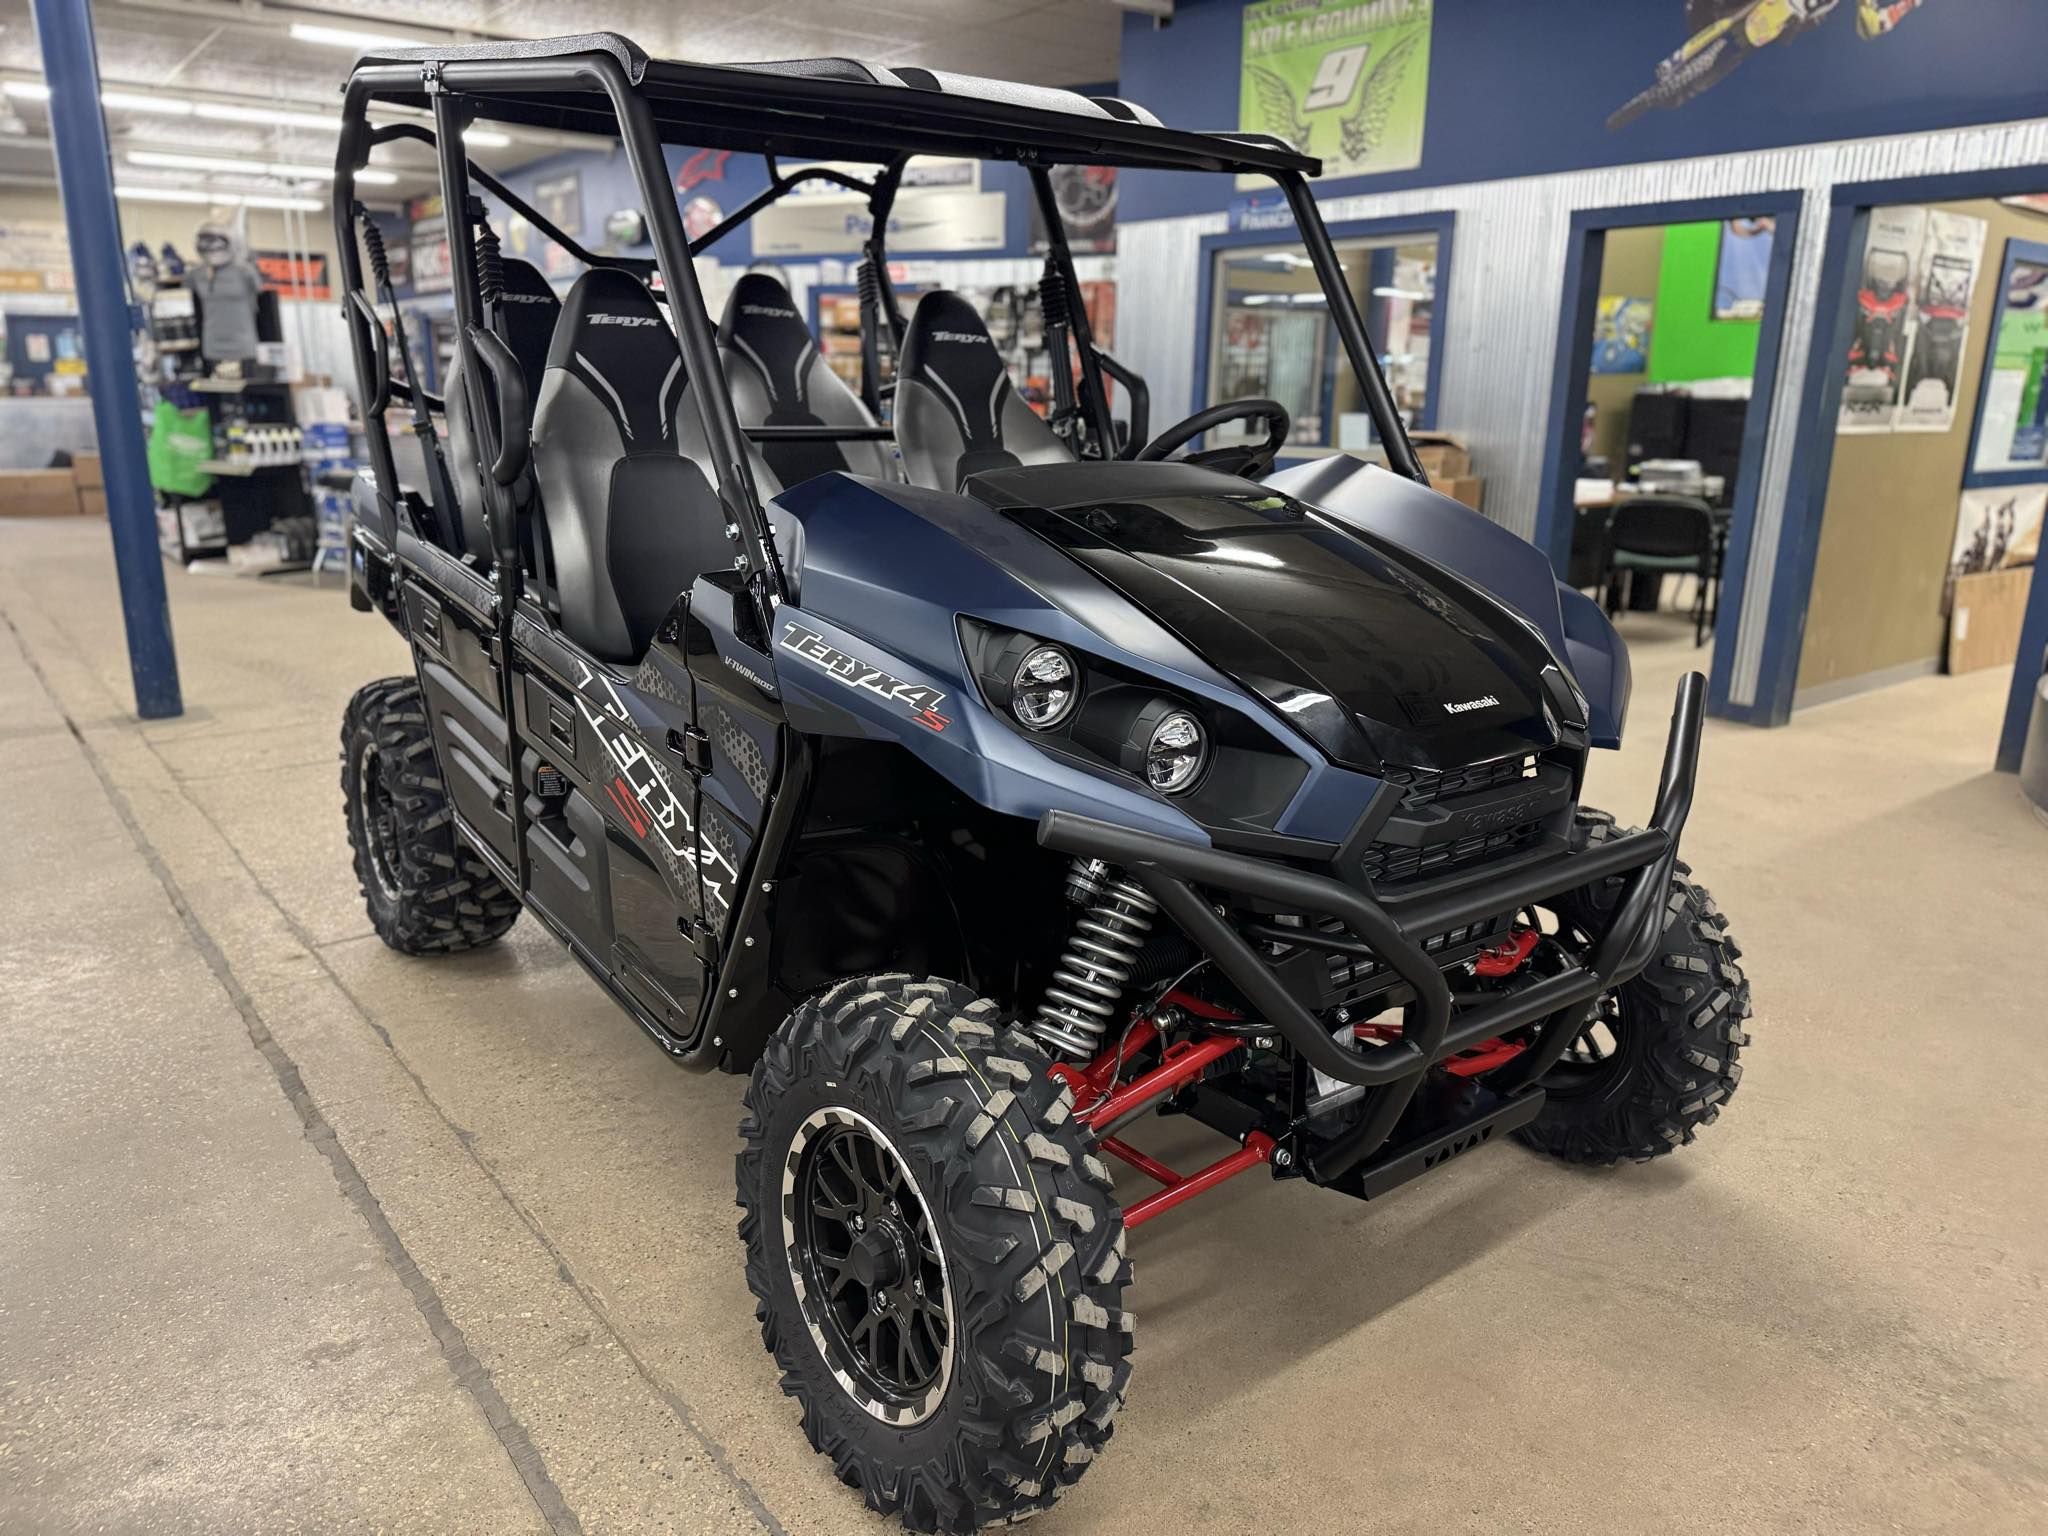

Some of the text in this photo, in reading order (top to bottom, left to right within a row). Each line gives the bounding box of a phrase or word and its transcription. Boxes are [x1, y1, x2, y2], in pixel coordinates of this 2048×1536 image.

[1303, 43, 1371, 113] 9
[1443, 694, 1501, 715] Kawasaki
[912, 709, 953, 732] S
